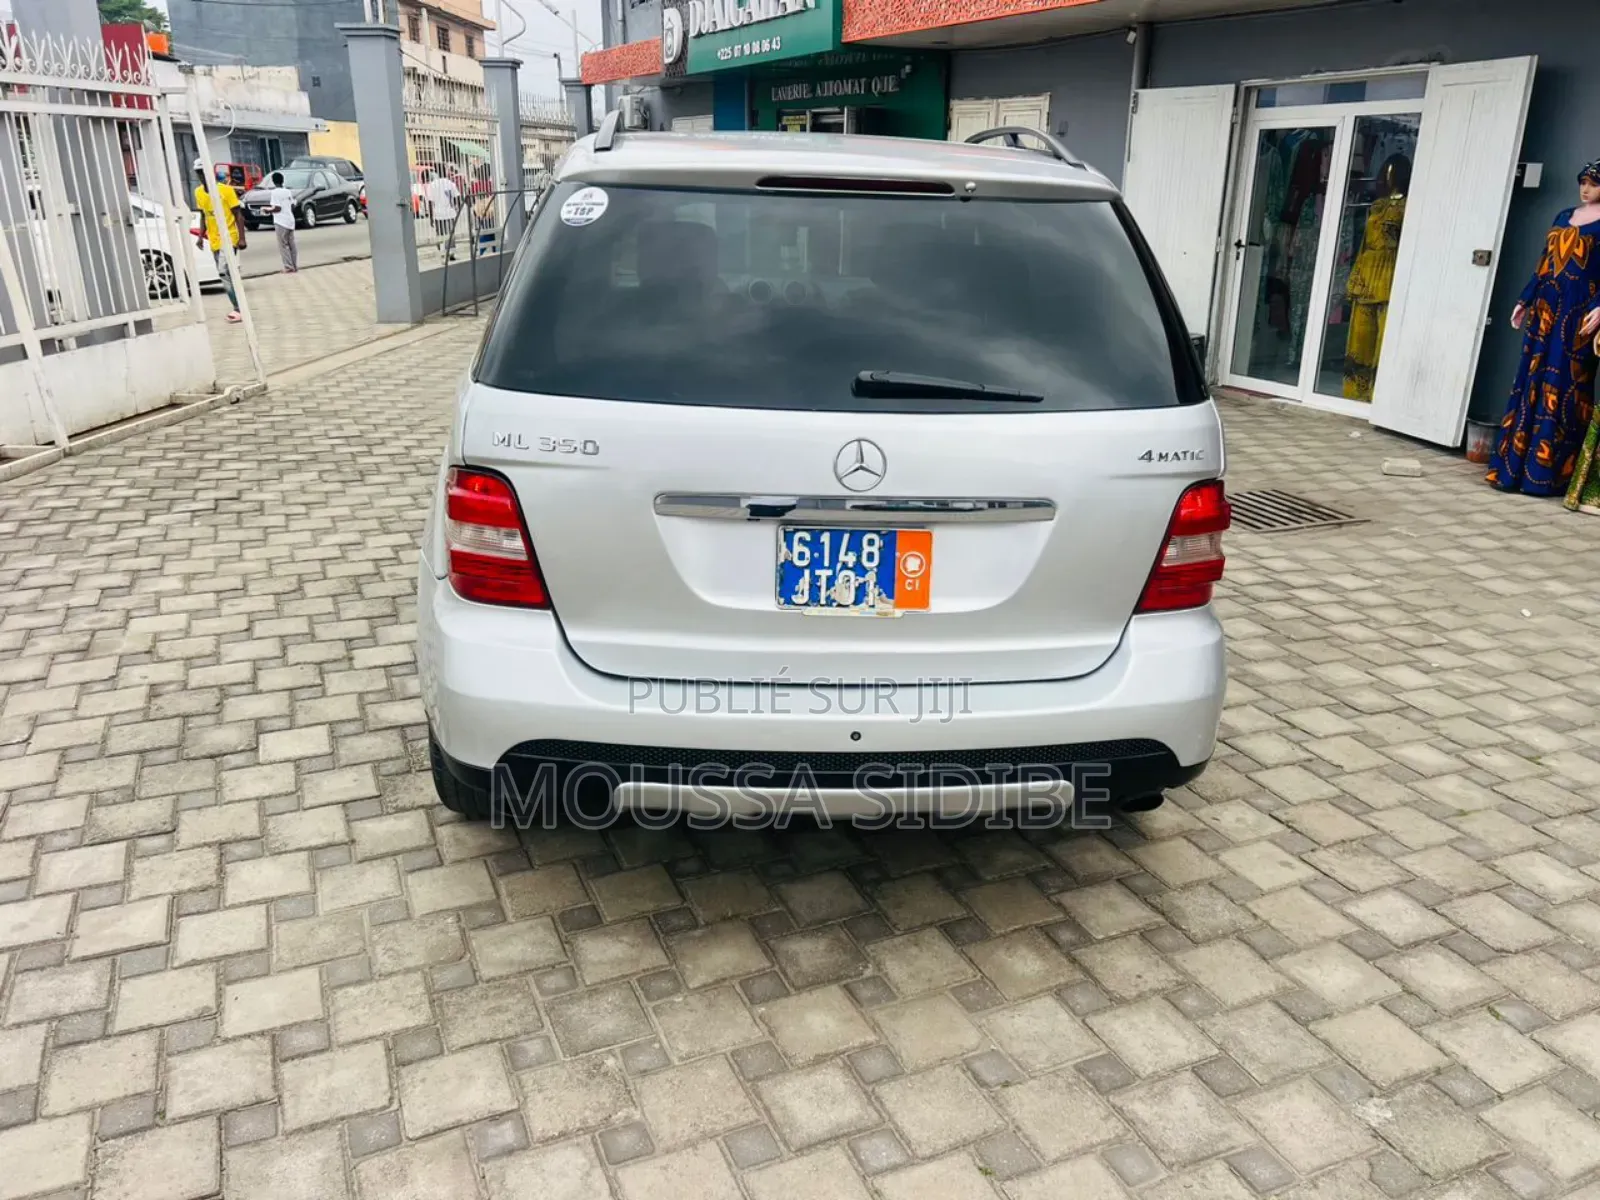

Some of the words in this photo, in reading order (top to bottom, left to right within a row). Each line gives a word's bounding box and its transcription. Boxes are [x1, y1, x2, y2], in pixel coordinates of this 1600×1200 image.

[492, 431, 529, 450] ML
[538, 435, 600, 456] 350
[792, 531, 880, 569] 6148
[904, 579, 920, 591] CI
